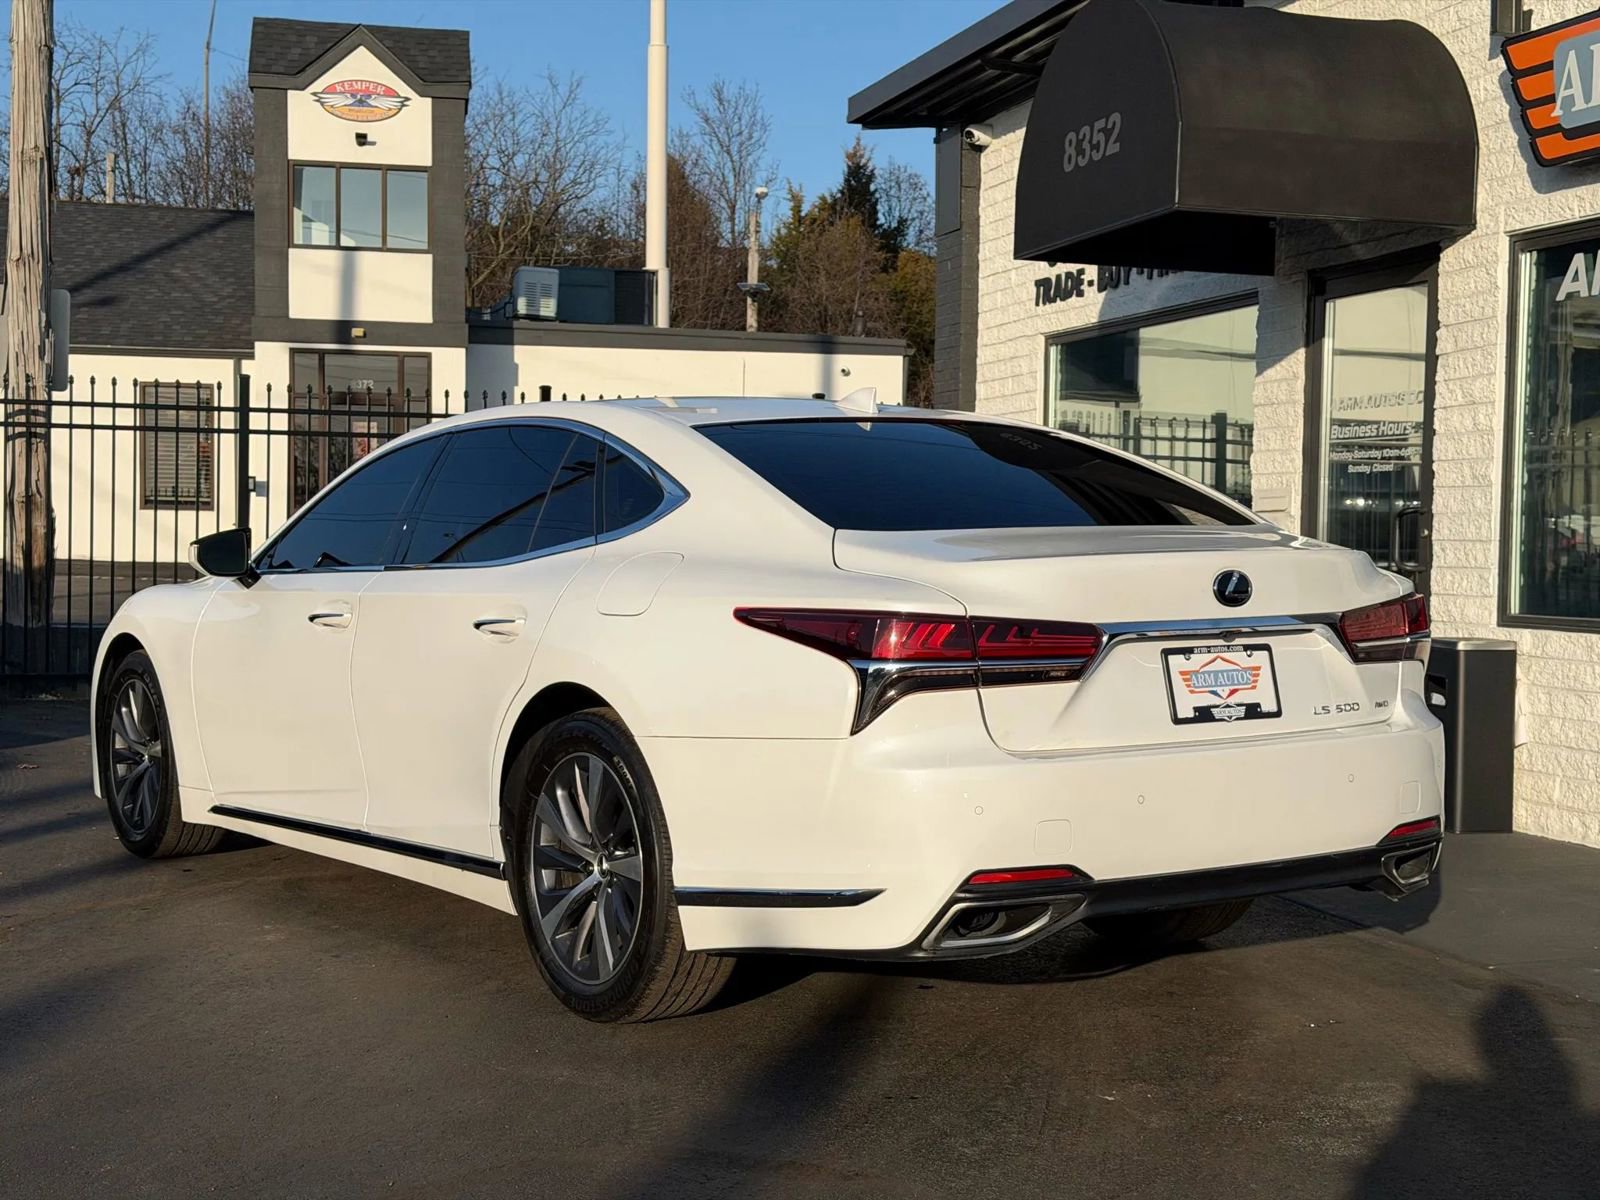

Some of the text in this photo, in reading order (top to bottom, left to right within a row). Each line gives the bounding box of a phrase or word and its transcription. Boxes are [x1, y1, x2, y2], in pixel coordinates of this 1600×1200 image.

[335, 81, 385, 95] KEMPER
[1063, 112, 1122, 172] 8352
[1034, 267, 1086, 307] TRADE
[1097, 264, 1132, 293] BUY
[1330, 423, 1378, 439] Business
[1347, 463, 1394, 474] Sunday Closed
[1193, 645, 1244, 654] arm-autos.com
[1190, 670, 1253, 687] ARM AUTOS
[1313, 700, 1389, 715] LS 500 AWD
